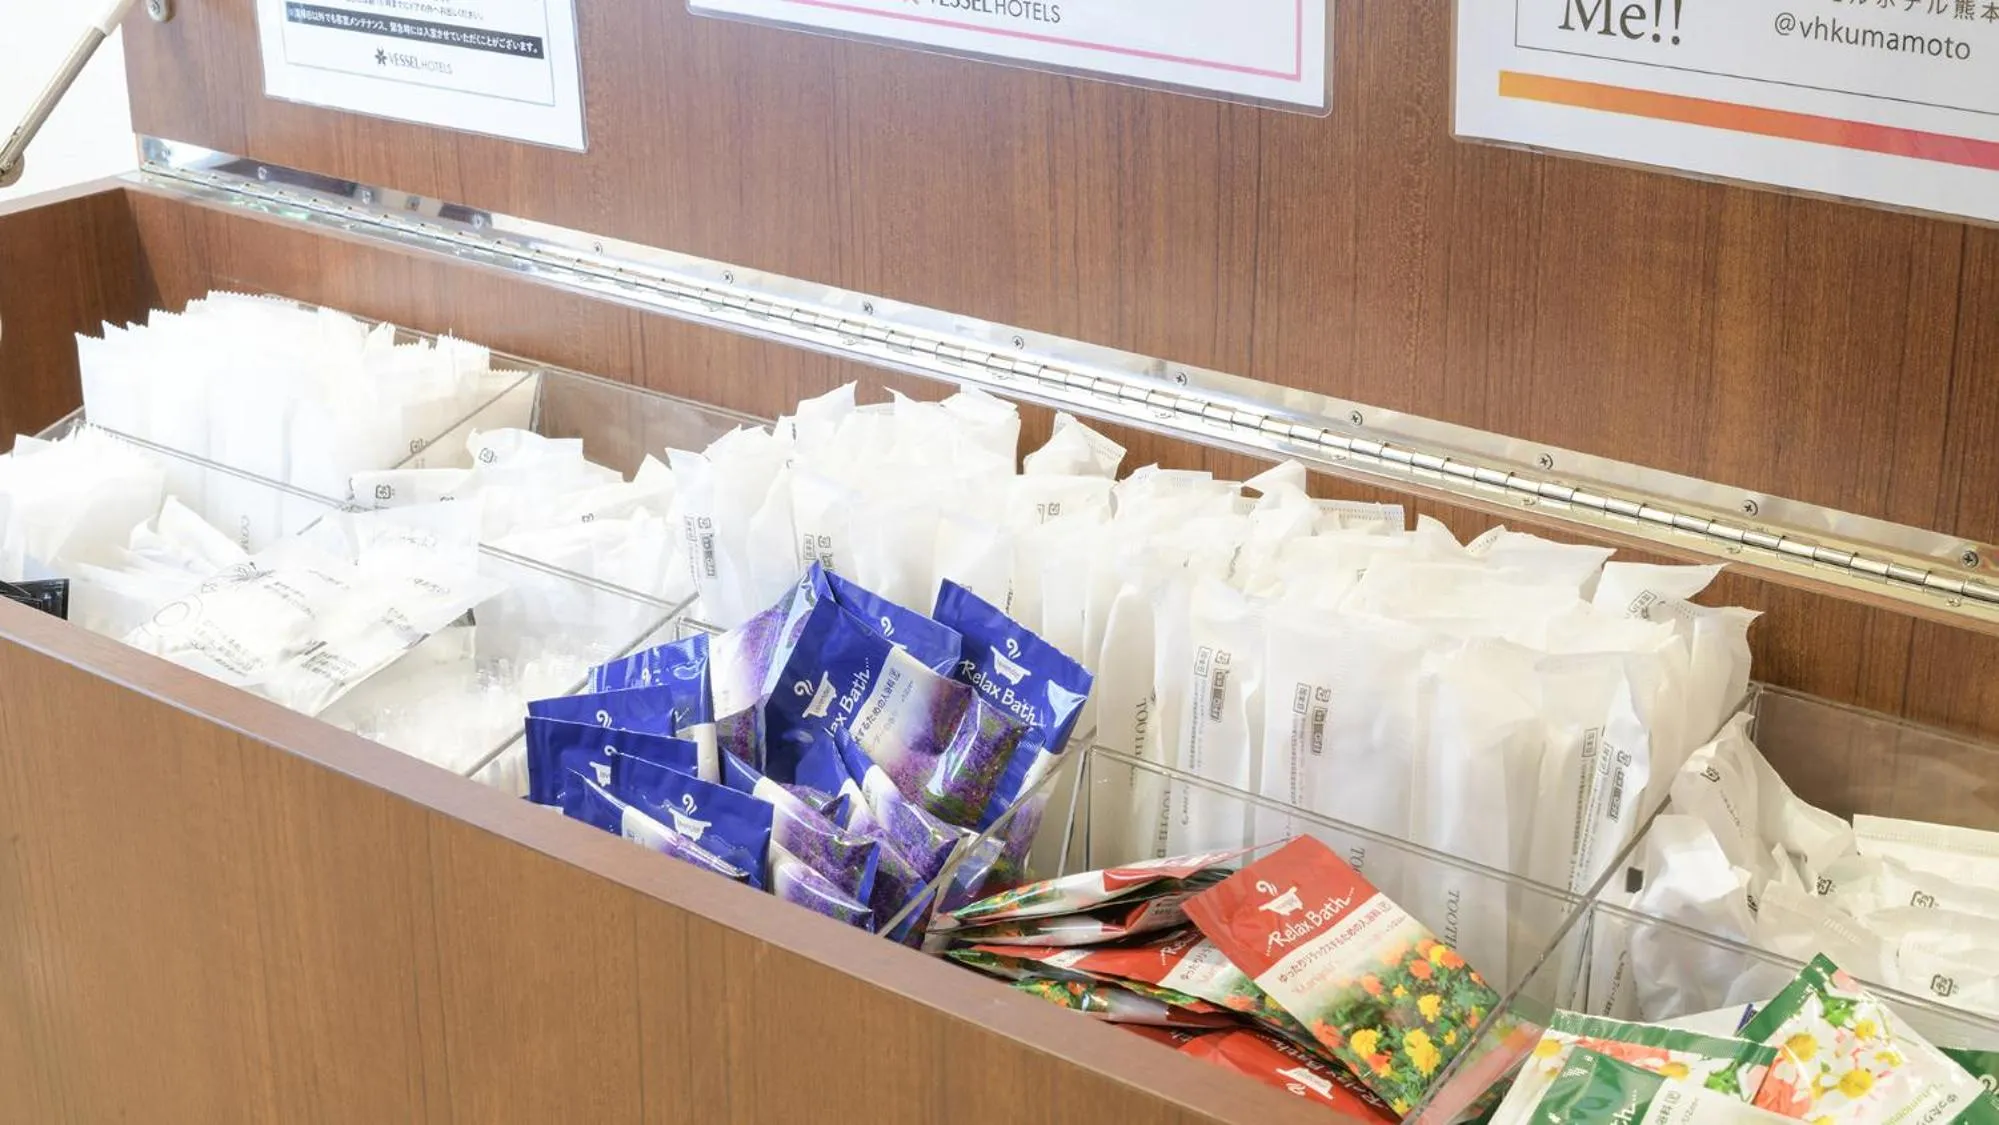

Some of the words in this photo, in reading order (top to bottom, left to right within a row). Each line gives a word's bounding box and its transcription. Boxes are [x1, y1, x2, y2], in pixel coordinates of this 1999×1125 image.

[994, 0, 1061, 24] HOTELS
[1557, 0, 1682, 46] Me!!
[1774, 12, 1971, 60] @vhkumamoto
[388, 52, 421, 70] VESSEL
[959, 659, 1000, 700] Relax
